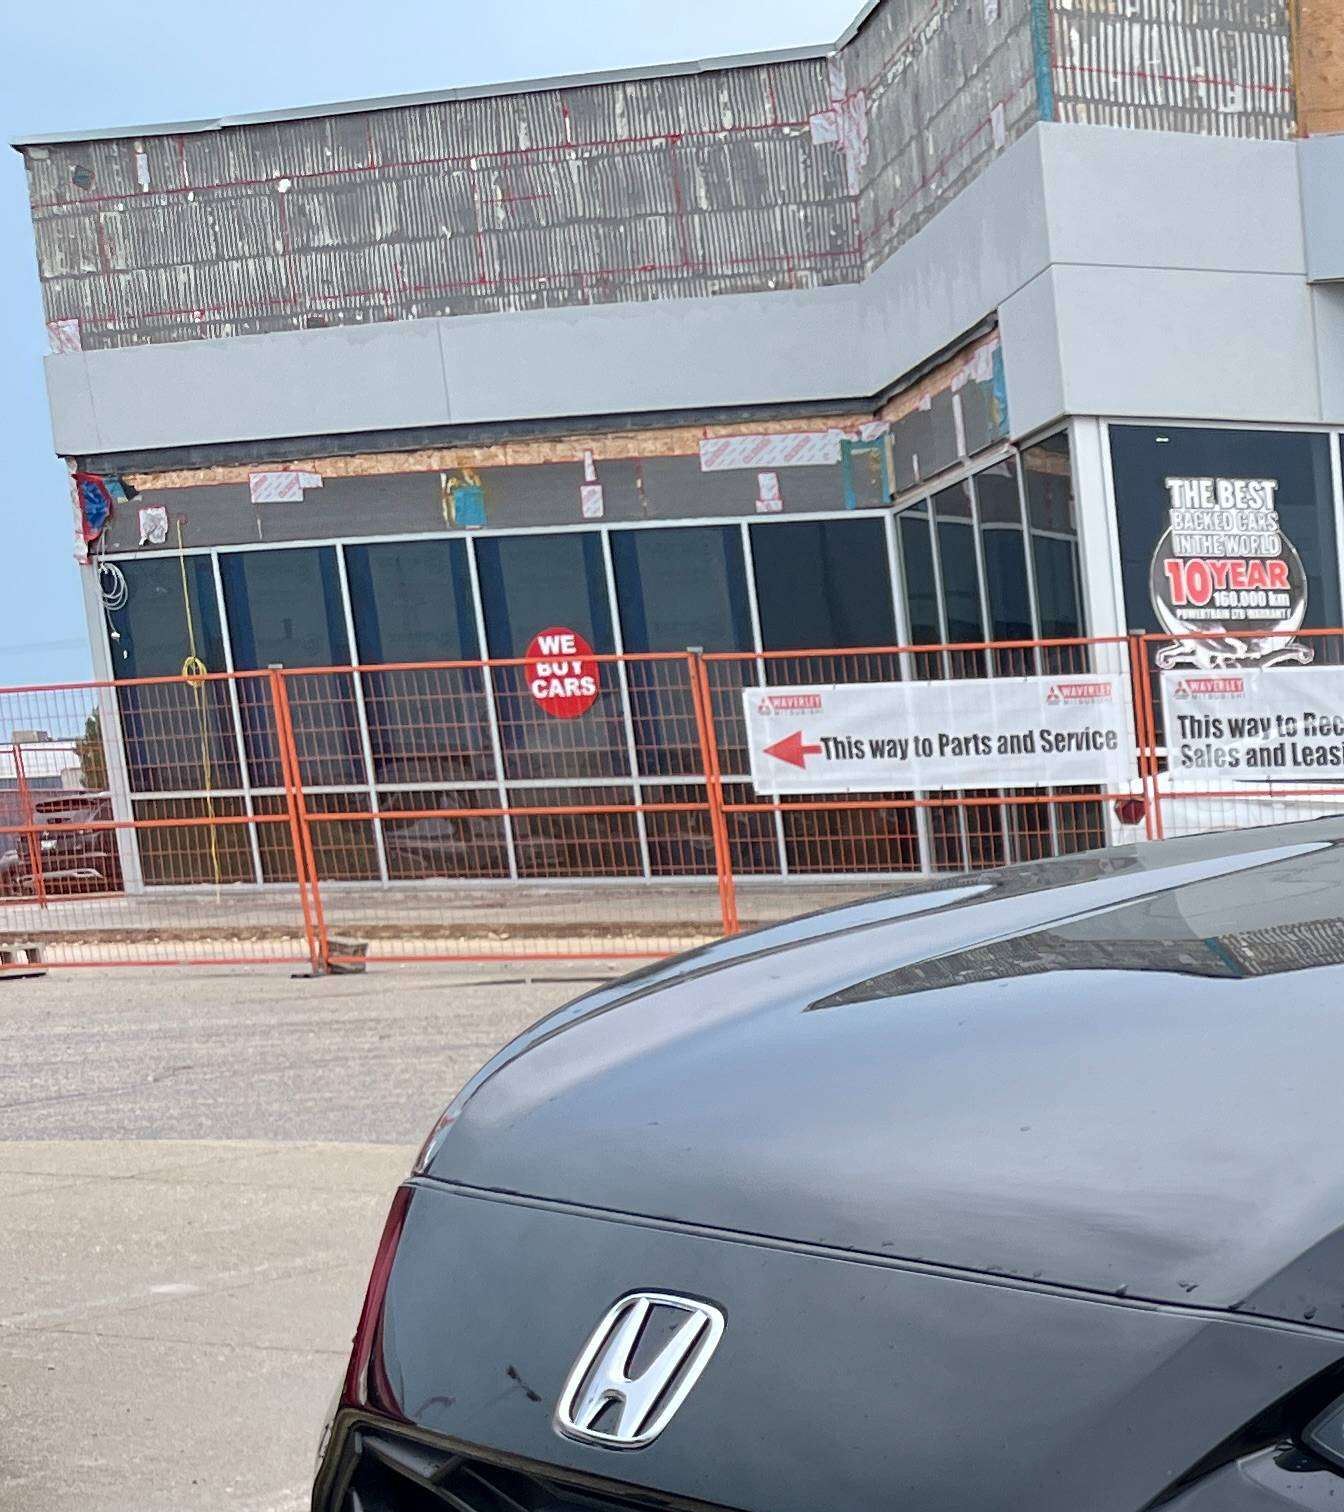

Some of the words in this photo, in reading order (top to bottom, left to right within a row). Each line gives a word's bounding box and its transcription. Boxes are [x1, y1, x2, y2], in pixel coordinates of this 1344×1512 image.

[1167, 478, 1214, 509] THE
[1218, 478, 1278, 510] BEST
[1173, 511, 1234, 531] BACKED
[1236, 511, 1279, 531] CARS
[1174, 533, 1190, 555] IN
[1191, 533, 1224, 556] THE
[1225, 533, 1281, 556] WORLD
[1209, 559, 1290, 589] YEAR
[537, 634, 577, 655] WE
[531, 676, 596, 698] CARS
[1177, 714, 1223, 739] This
[1228, 716, 1271, 740] way
[1276, 714, 1297, 738] to
[820, 736, 865, 760] This
[870, 738, 910, 761] way
[915, 735, 933, 757] to
[939, 732, 992, 757] Parts
[997, 730, 1034, 754] and
[1041, 727, 1118, 752] Service
[1181, 744, 1240, 769] Sales
[1246, 743, 1286, 767] and
